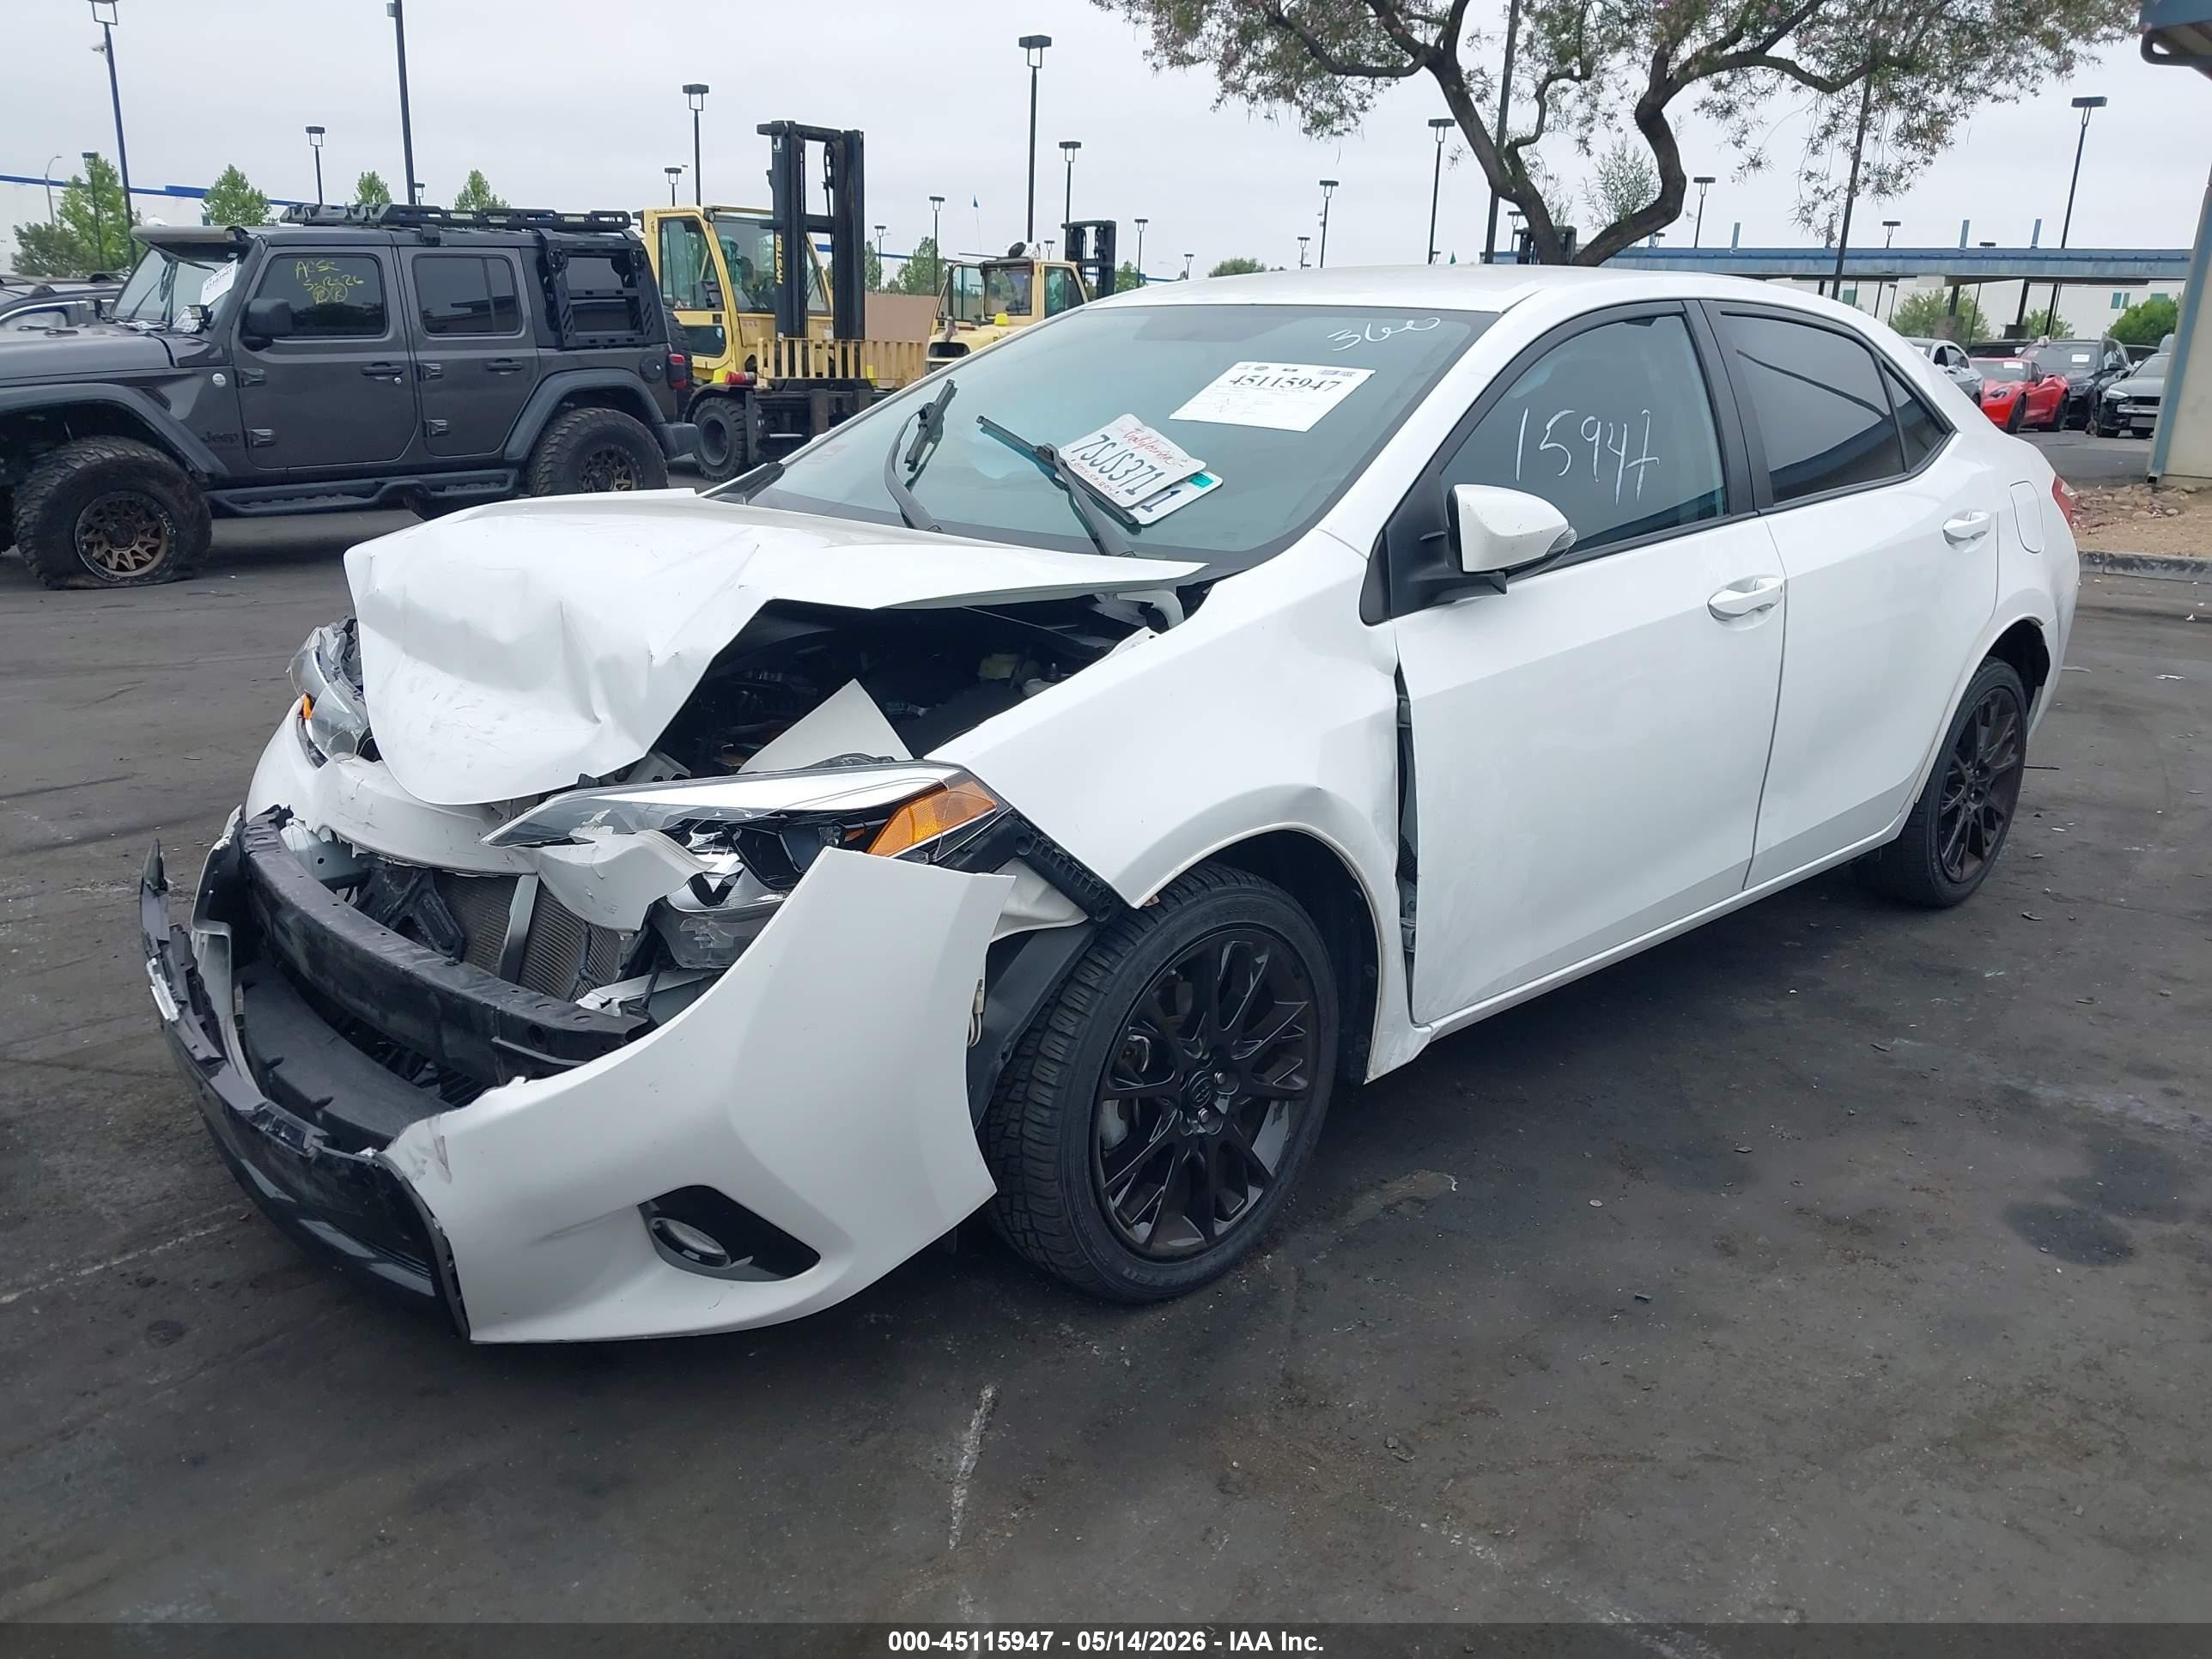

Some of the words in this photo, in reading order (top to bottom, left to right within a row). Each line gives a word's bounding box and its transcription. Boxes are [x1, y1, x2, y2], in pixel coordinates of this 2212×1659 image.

[1229, 374, 1342, 392] 45115947
[1072, 434, 1165, 495] 7SJS371
[1122, 428, 1176, 465] California
